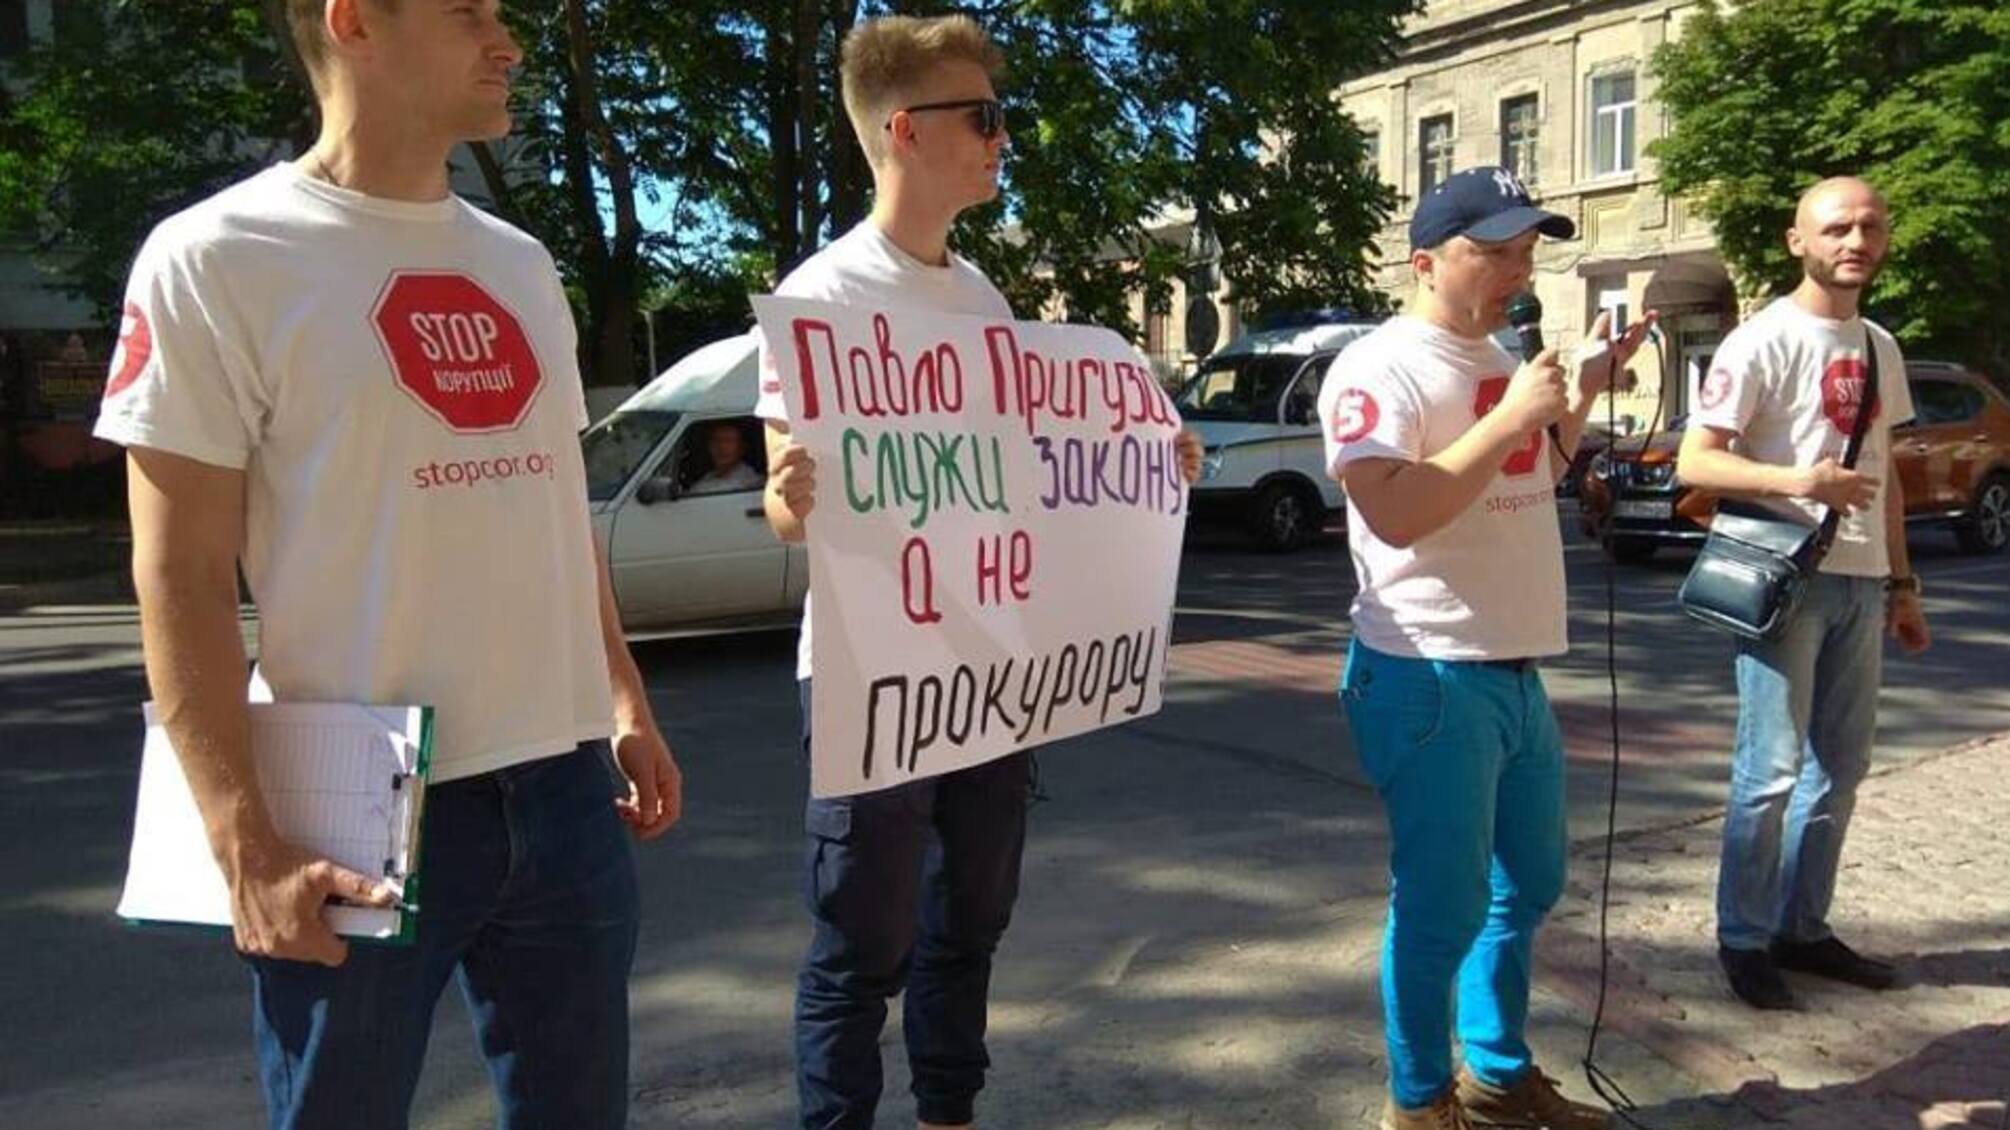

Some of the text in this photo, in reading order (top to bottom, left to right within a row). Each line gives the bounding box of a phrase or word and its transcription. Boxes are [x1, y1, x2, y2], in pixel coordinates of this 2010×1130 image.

[409, 311, 499, 362] STOP
[792, 312, 1176, 434] Павло Пригуза
[414, 453, 553, 489] stopcor.o
[977, 530, 1033, 606] не
